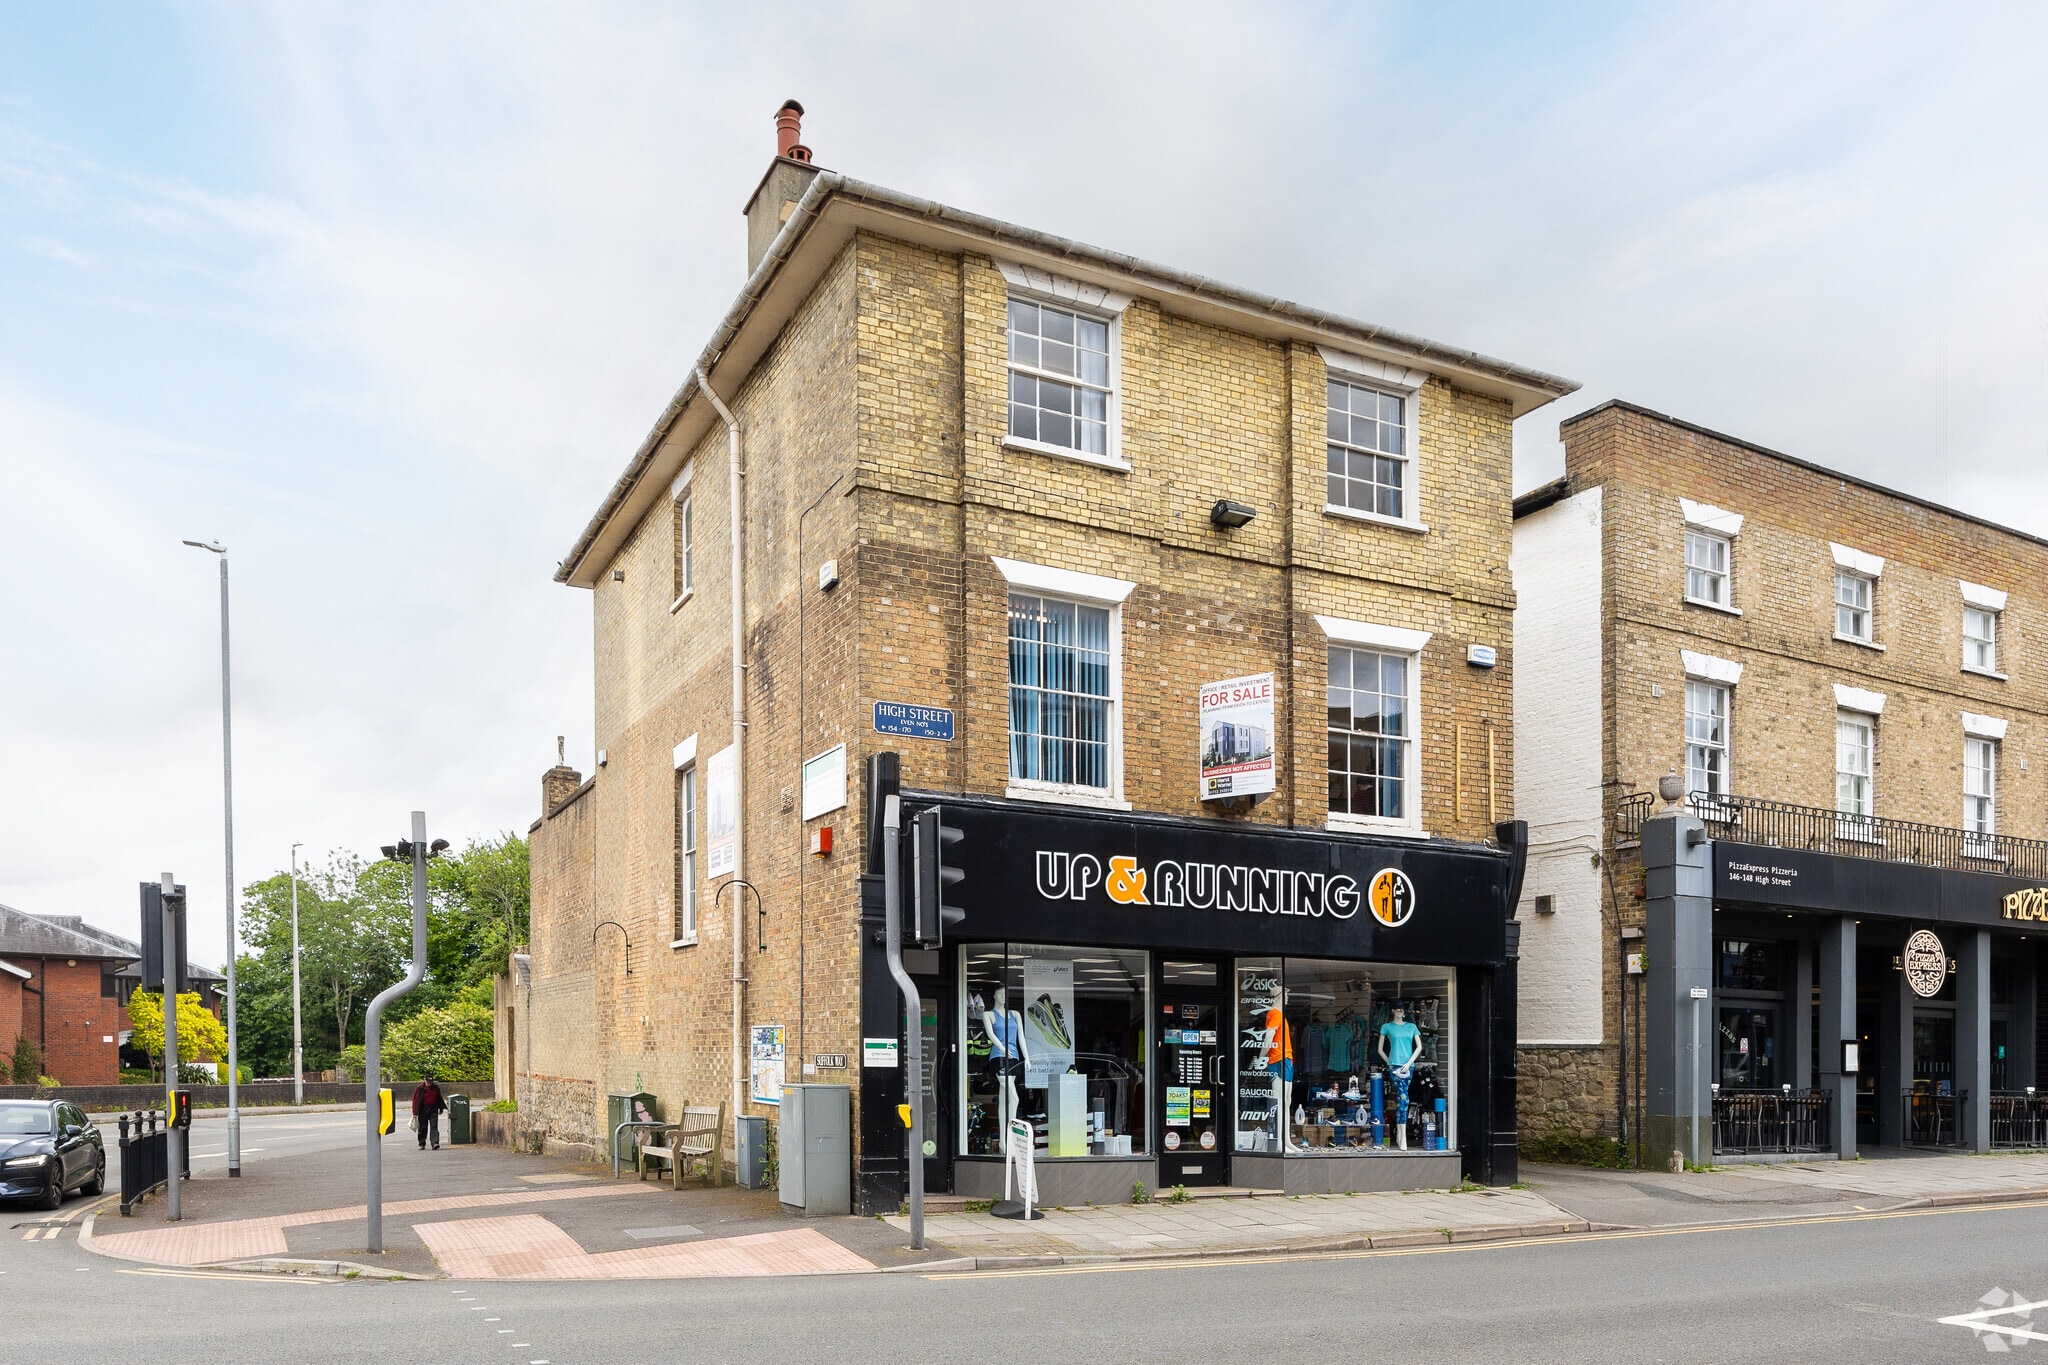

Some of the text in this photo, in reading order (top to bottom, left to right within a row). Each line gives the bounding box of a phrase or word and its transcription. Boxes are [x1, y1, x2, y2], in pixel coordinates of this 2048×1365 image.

[1202, 684, 1270, 708] FOR SALE
[878, 704, 950, 723] HIGH STREET
[1243, 762, 1271, 770] AFFECTED
[1728, 861, 1798, 876] PizzaExpress Pizzeria
[1036, 851, 1360, 919] UP & RUNNING
[1729, 872, 1792, 886] 146-148 High Street
[1915, 953, 1936, 962] PIZZA
[1909, 960, 1941, 971] EXPRESS
[1184, 1033, 1198, 1041] OPEN
[817, 1055, 844, 1066] SUFFOLK WAY
